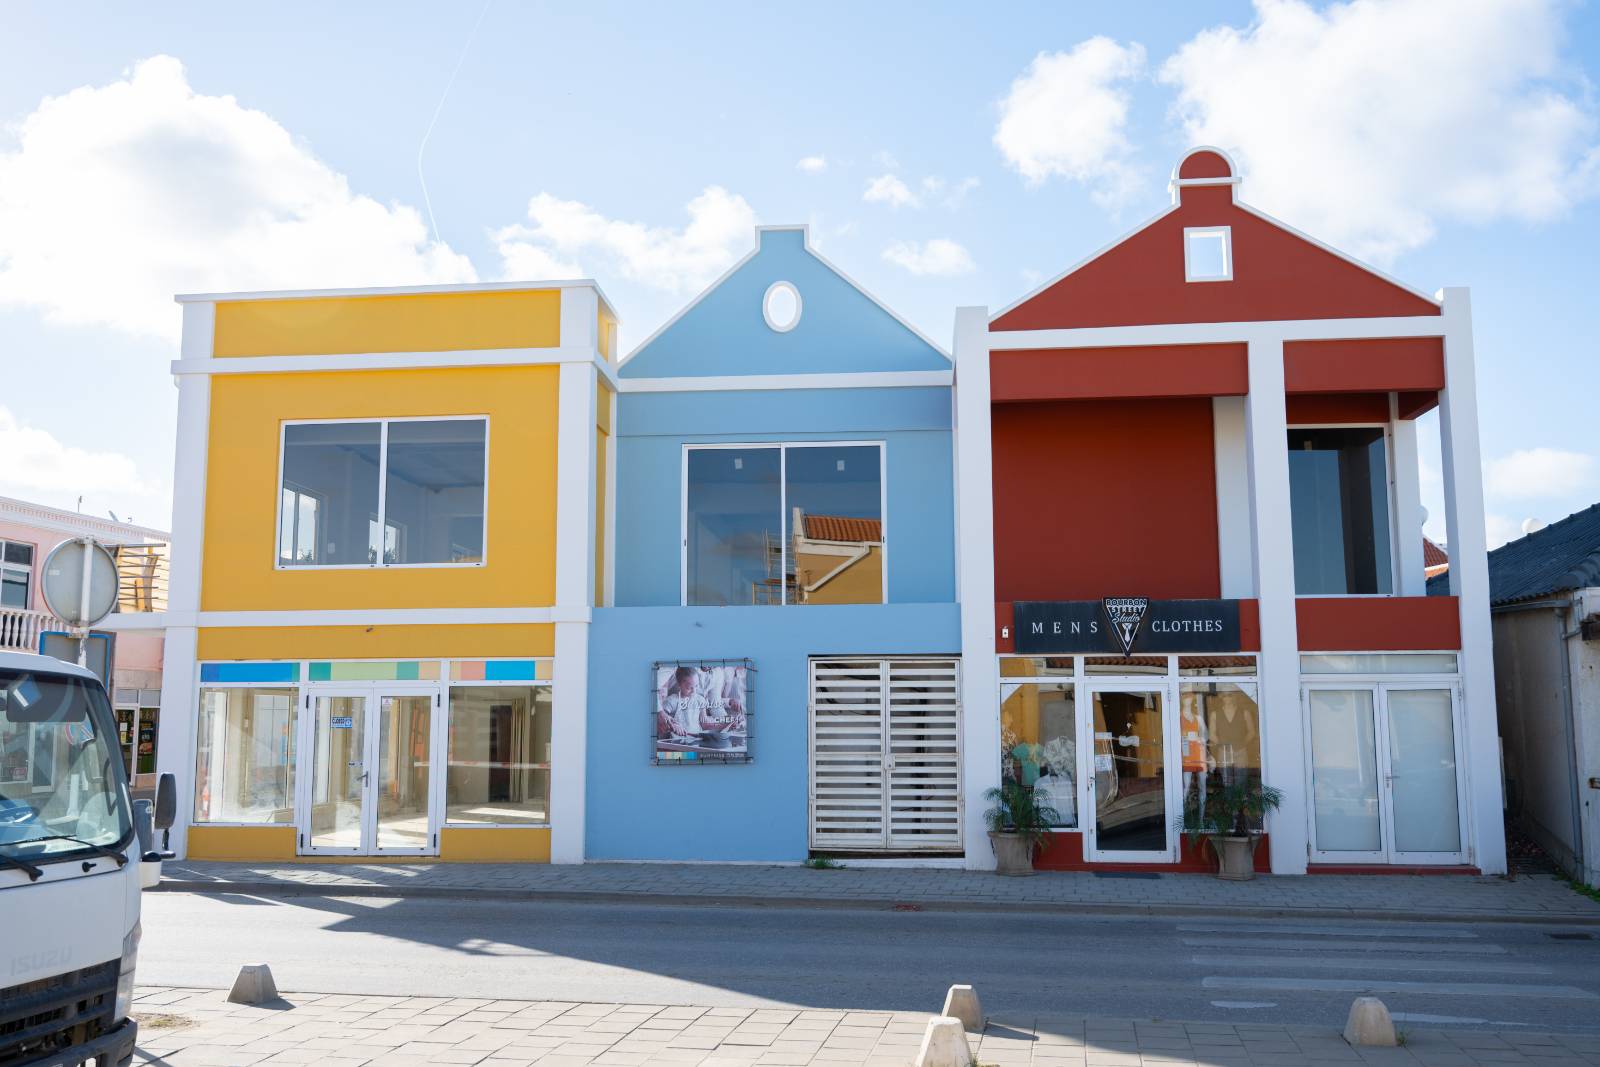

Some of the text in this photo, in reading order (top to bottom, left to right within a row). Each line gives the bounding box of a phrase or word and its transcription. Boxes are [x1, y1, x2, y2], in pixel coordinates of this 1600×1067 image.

[1105, 598, 1147, 606] BOURBON
[1111, 612, 1140, 624] Studio
[1031, 619, 1223, 634] MENS CLOTHES
[10, 944, 73, 977] ISUZU
